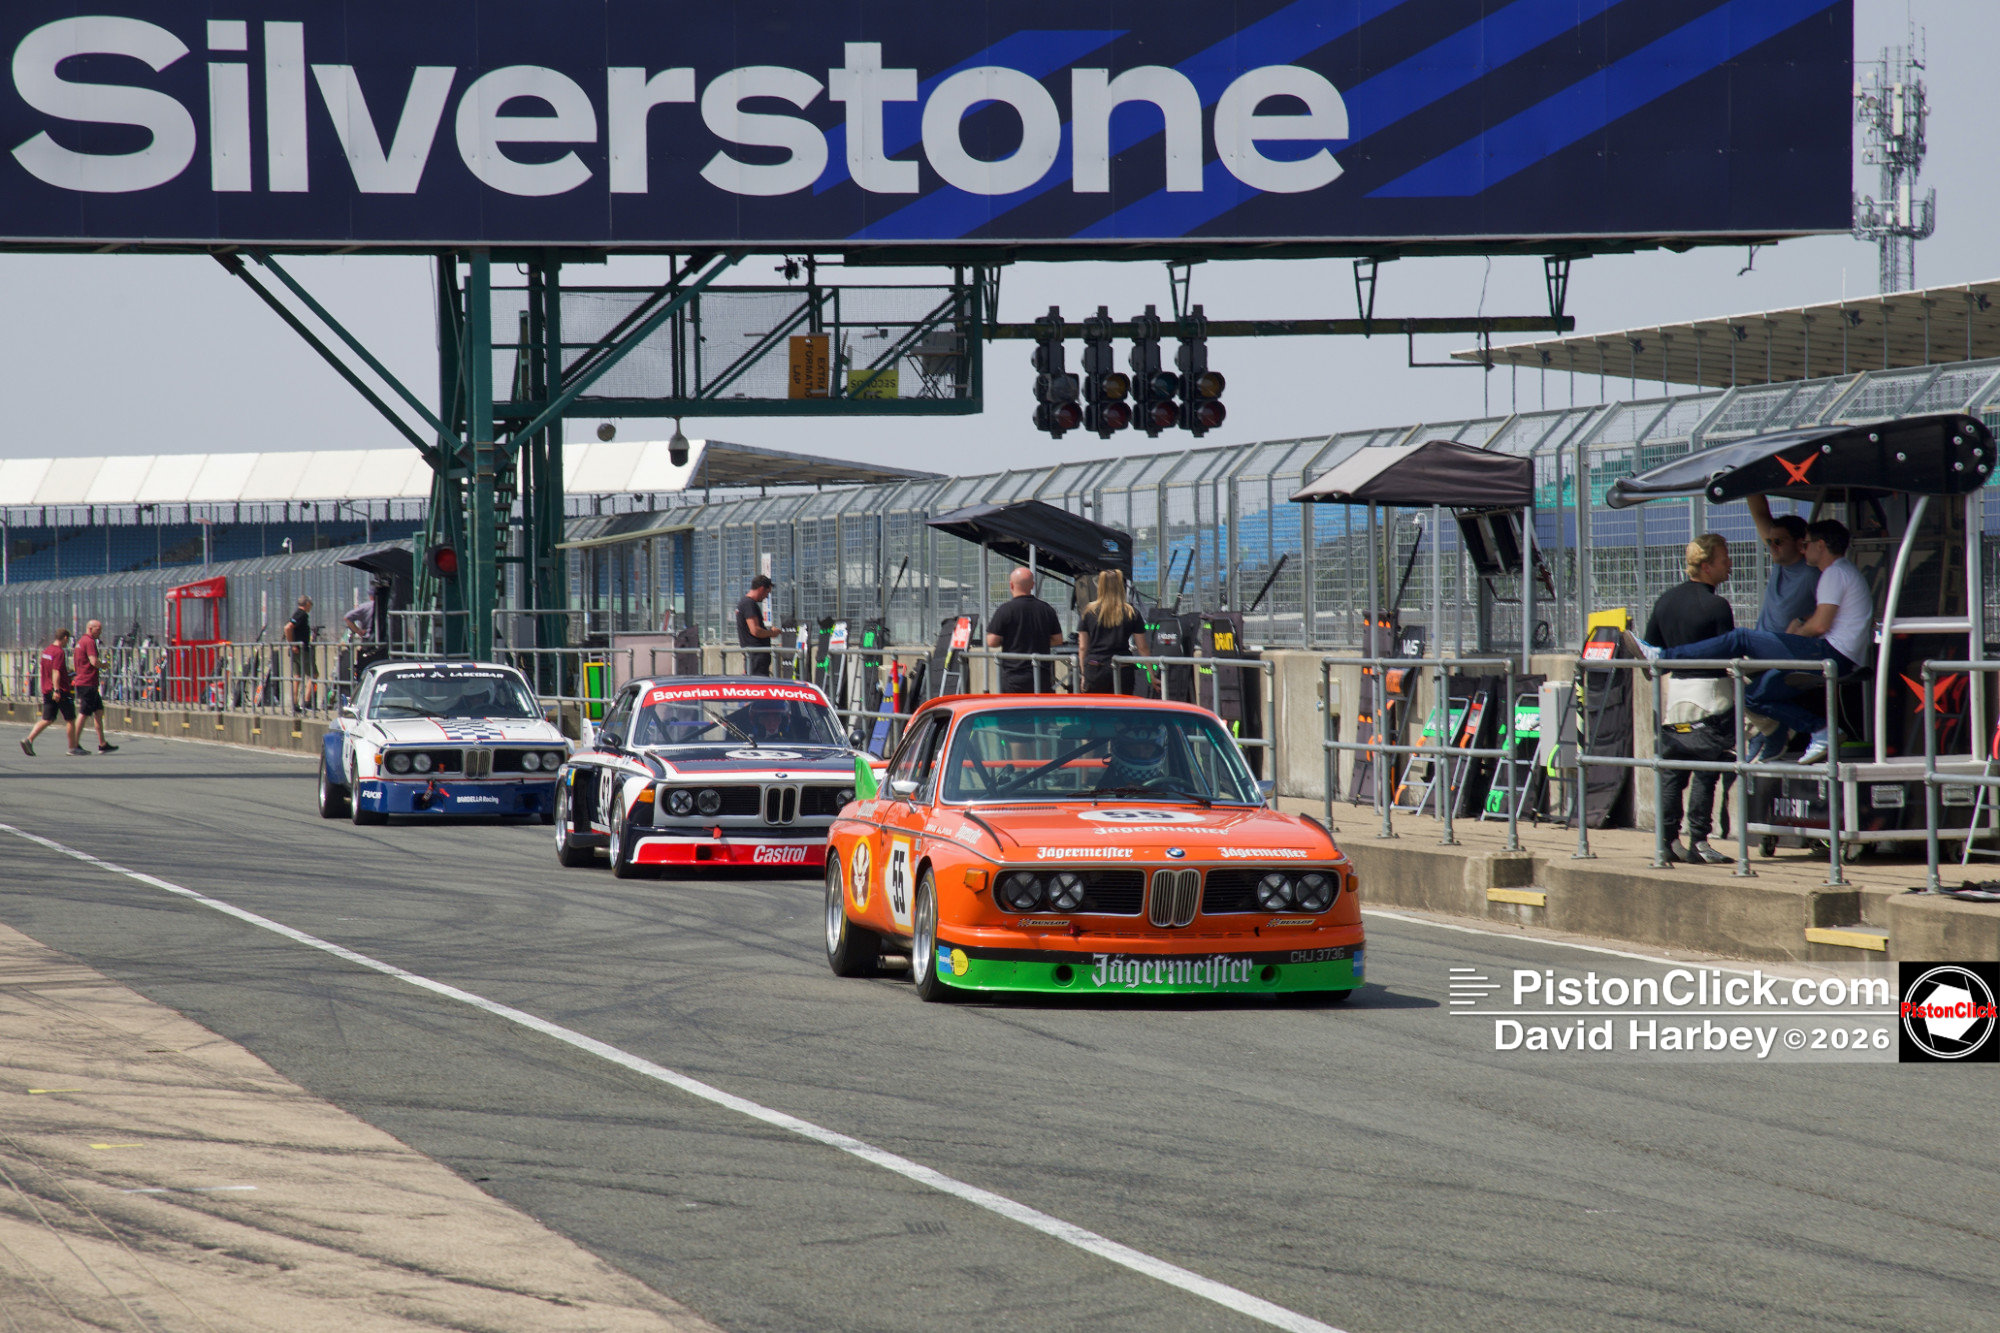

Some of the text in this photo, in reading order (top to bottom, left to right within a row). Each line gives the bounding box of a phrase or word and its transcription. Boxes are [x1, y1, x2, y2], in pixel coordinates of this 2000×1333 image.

[11, 15, 1349, 195] Silverstone
[793, 364, 802, 385] LAP
[804, 343, 813, 398] FORMATIO
[818, 357, 826, 391] EXTRA
[653, 687, 817, 702] Bavarian Motor Works
[1101, 810, 1175, 819] 55
[1773, 797, 1811, 820] PURSUIT
[752, 845, 809, 863] Castrol
[1036, 846, 1134, 859] Jägermeister
[1219, 847, 1308, 859] Jägermeister
[892, 849, 906, 915] 55
[1290, 950, 1314, 963] CHJ
[1091, 953, 1254, 989] Jägermeister
